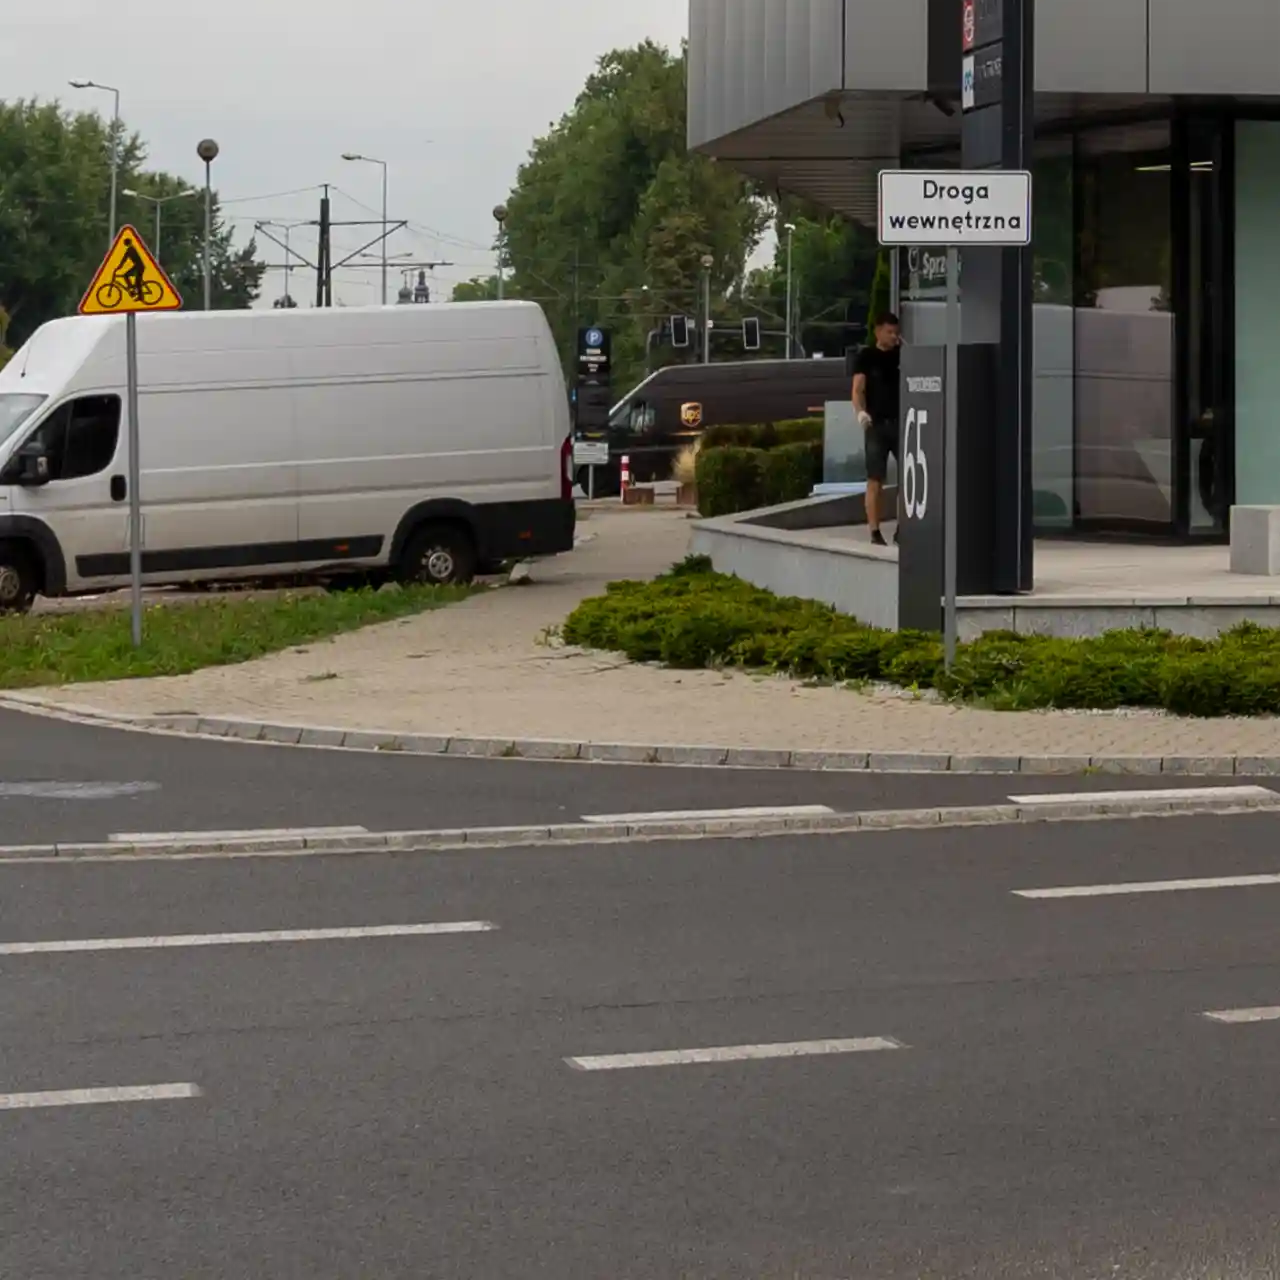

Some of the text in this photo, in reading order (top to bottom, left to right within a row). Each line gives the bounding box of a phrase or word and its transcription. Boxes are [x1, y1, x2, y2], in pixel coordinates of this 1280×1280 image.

[923, 179, 989, 205] Droga
[889, 211, 1021, 234] wewnętrzna
[903, 407, 928, 520] 65
